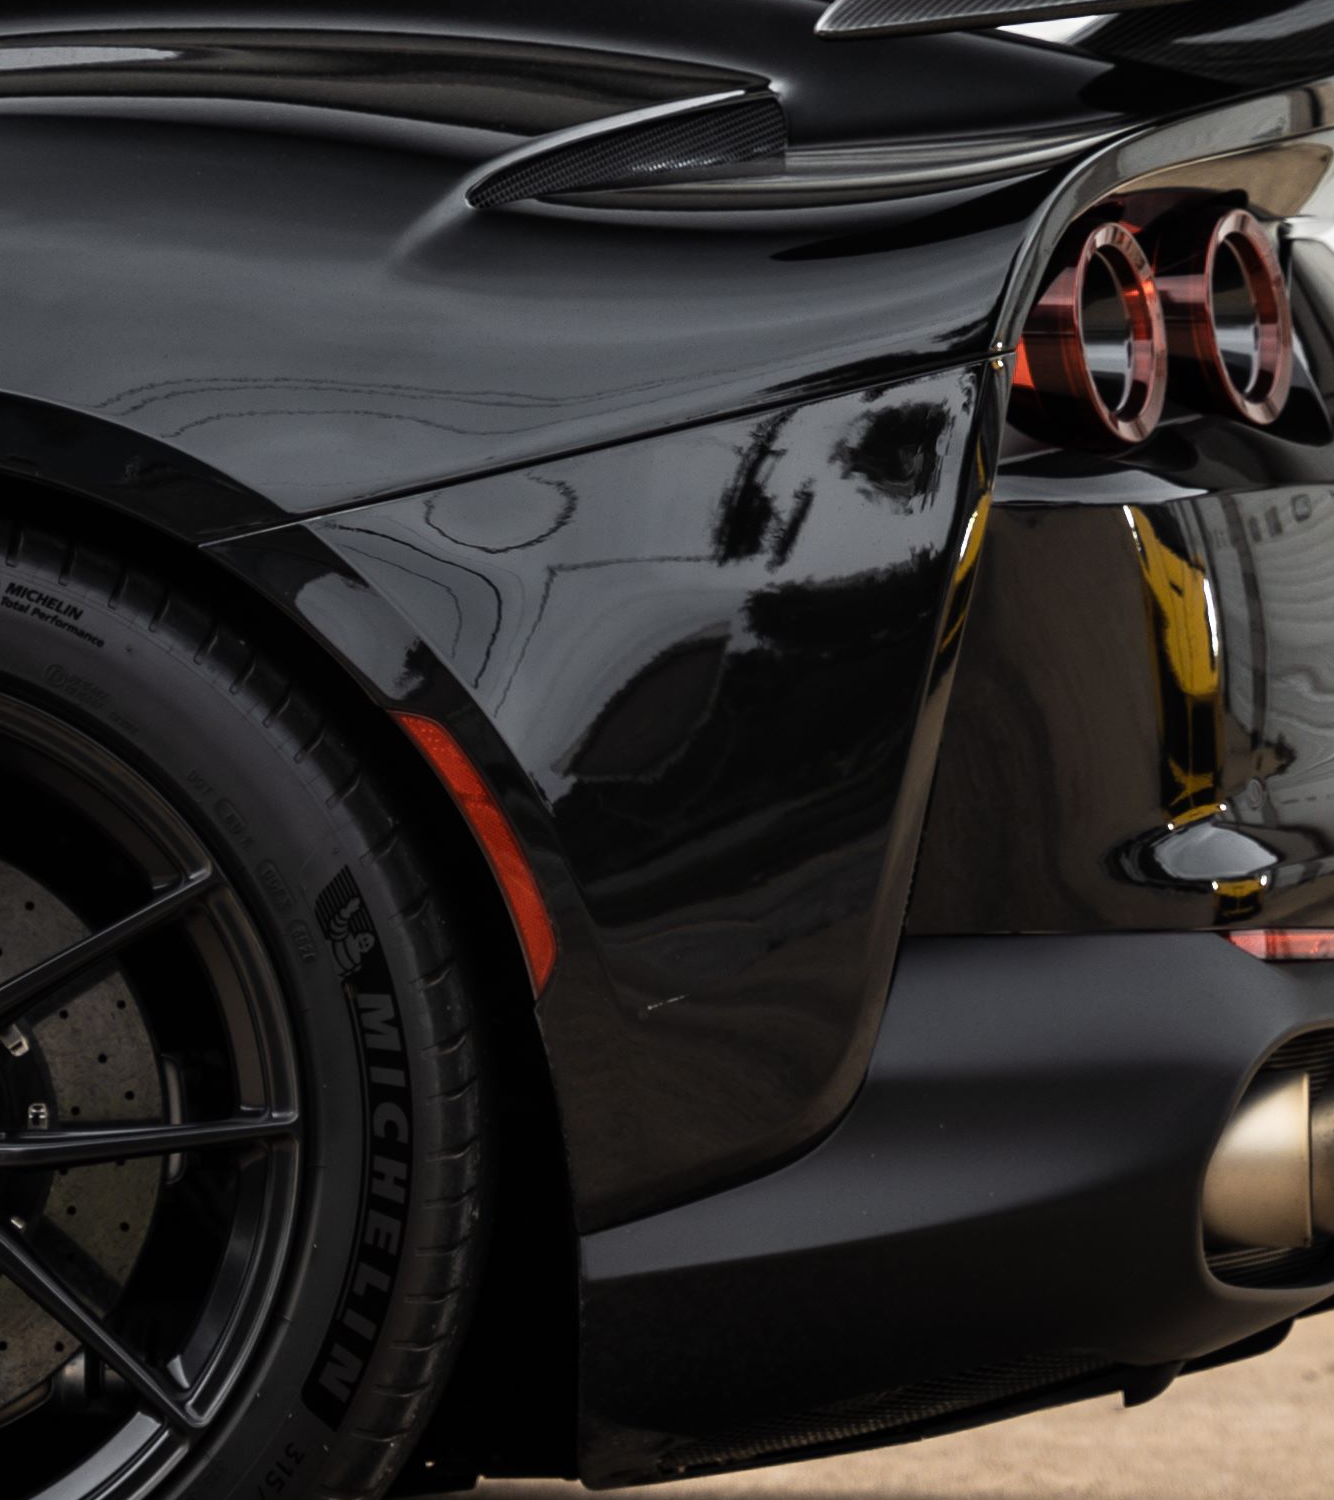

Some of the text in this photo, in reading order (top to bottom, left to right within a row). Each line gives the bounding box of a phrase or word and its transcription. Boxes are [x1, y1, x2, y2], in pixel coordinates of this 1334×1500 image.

[1, 596, 105, 648] Total Performance
[5, 583, 83, 620] MICHELIN
[318, 993, 409, 1401] MICHELIN
